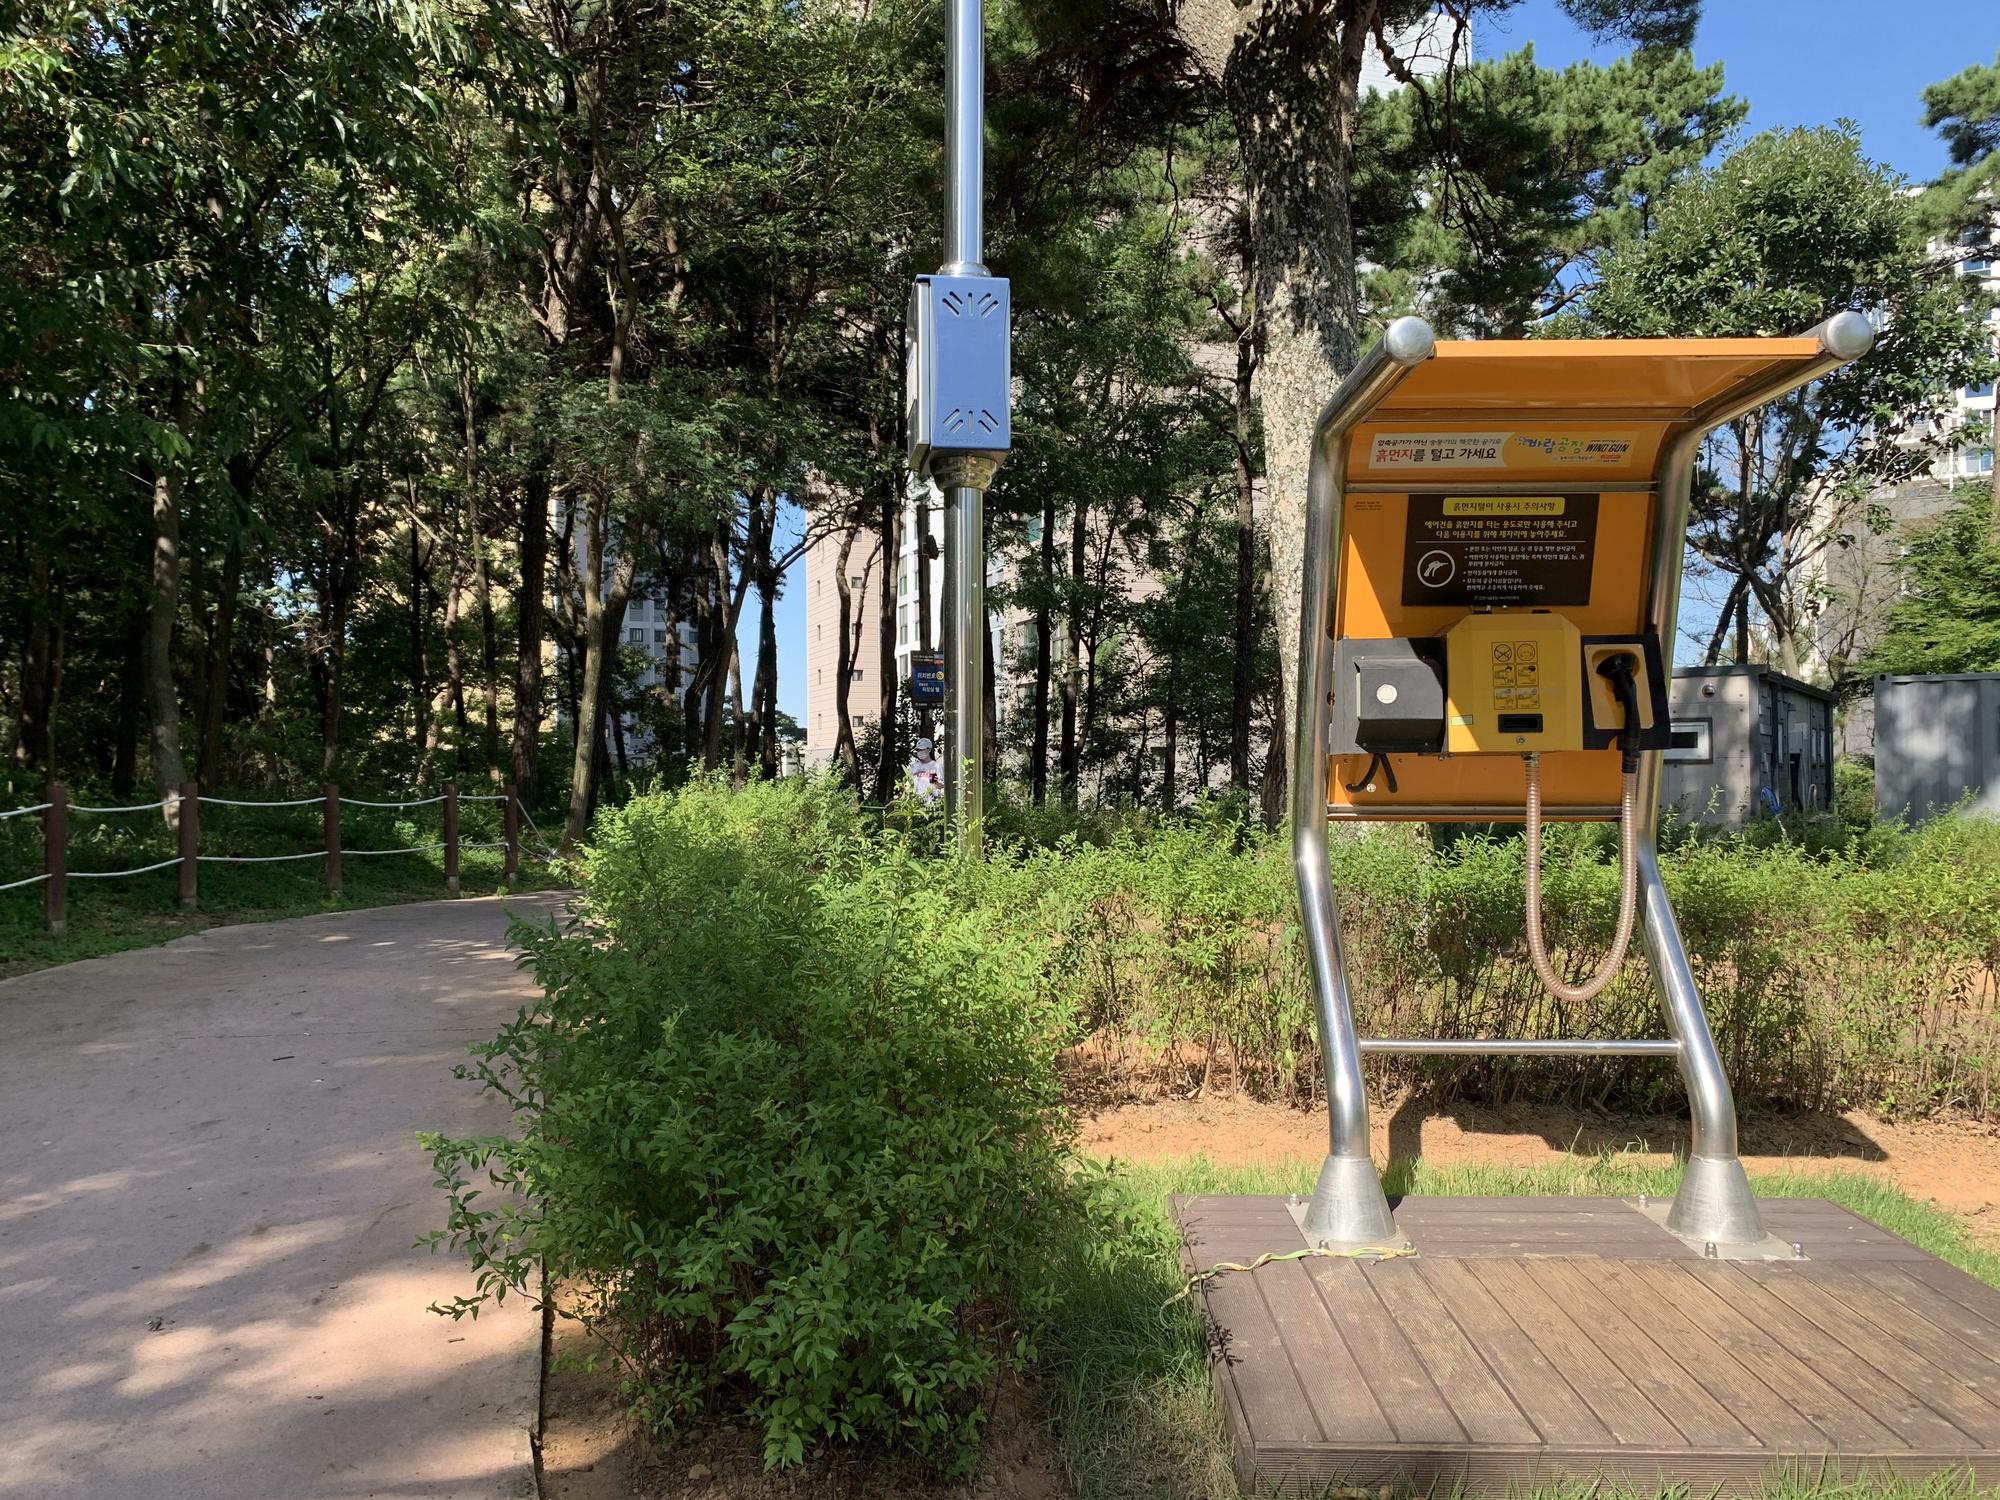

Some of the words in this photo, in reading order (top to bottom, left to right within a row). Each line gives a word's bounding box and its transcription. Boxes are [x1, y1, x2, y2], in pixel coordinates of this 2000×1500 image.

[1529, 437, 1584, 454] 바람공장
[1585, 443, 1609, 452] WIND
[1608, 443, 1630, 452] GUN
[1376, 449, 1426, 462] 흙먼지를
[1431, 448, 1455, 462] 털고
[1459, 448, 1497, 459] 가세요
[1453, 502, 1493, 512] 흙먼지털이
[1496, 502, 1520, 511] 사용시
[1523, 502, 1555, 512] 주의사항
[1424, 520, 1453, 529] 에어건을
[1456, 520, 1483, 529] 흙먼지를
[1486, 520, 1500, 529] 터는
[1502, 520, 1531, 529] 용도로만
[1533, 520, 1554, 528] 사용해
[1556, 520, 1577, 528] 주시고
[1435, 530, 1450, 538] 다음
[1452, 530, 1481, 538] 이용자를
[1483, 530, 1497, 538] 위해
[1499, 530, 1528, 538] 제자리에
